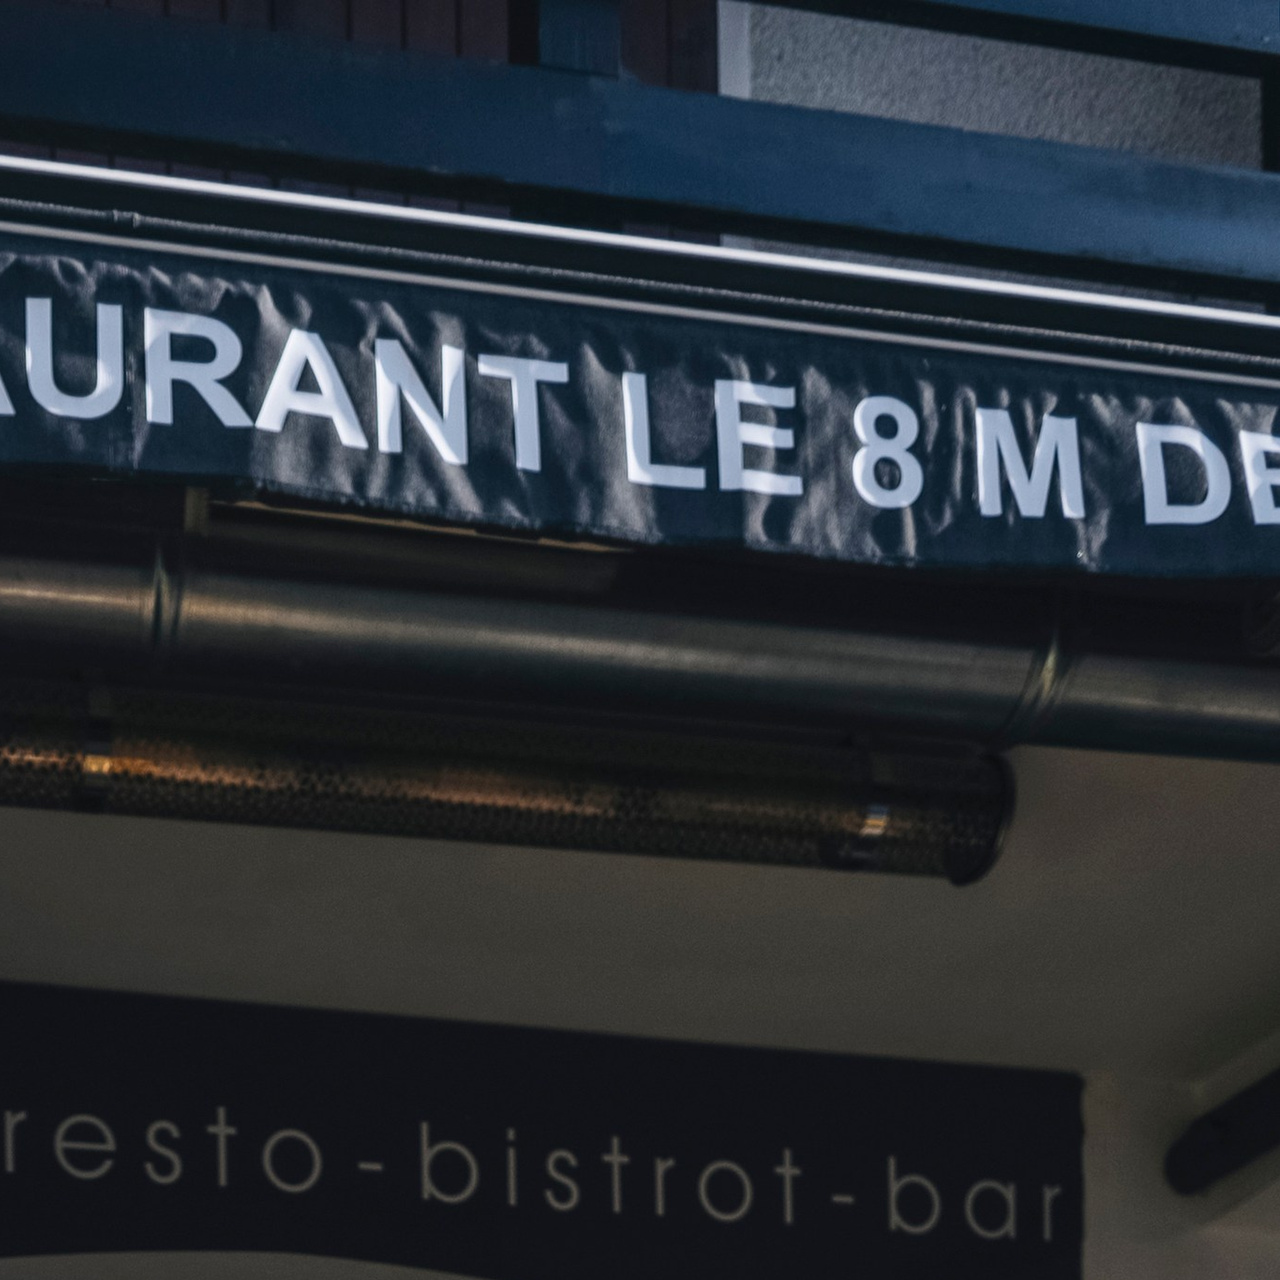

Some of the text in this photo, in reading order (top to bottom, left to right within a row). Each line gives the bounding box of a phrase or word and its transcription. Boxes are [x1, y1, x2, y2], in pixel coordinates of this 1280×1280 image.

[621, 371, 804, 498] LE
[851, 395, 924, 511] 8
[974, 406, 1087, 519] M
